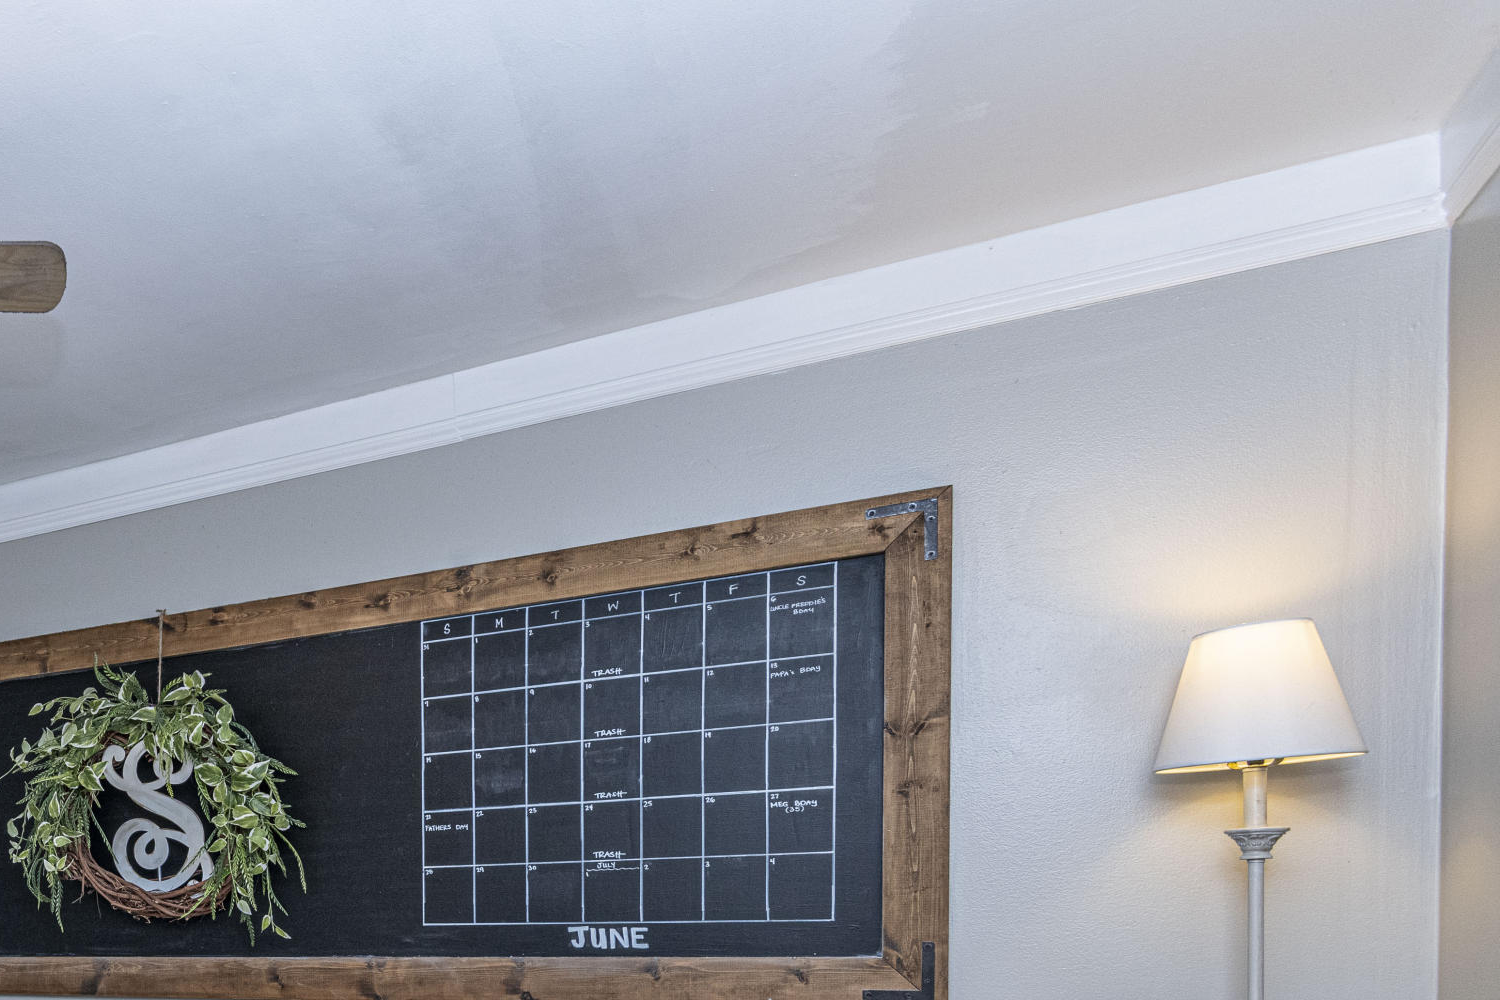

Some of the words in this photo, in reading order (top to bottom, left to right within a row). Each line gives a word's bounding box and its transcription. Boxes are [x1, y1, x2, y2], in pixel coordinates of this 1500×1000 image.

[796, 575, 807, 586] S
[729, 583, 739, 595] F
[668, 591, 682, 603] T
[607, 600, 619, 612] W
[550, 610, 560, 620] T
[495, 617, 504, 629] M
[444, 623, 451, 635] S
[591, 667, 623, 677] TRASH
[594, 728, 627, 738] TRASH
[594, 790, 628, 799] TRASH
[643, 800, 653, 808] 25
[425, 824, 451, 832] FATHERS
[593, 851, 626, 859] TRASH
[596, 861, 616, 869] JULY
[769, 857, 776, 865] 4
[568, 926, 650, 950] JUNE
